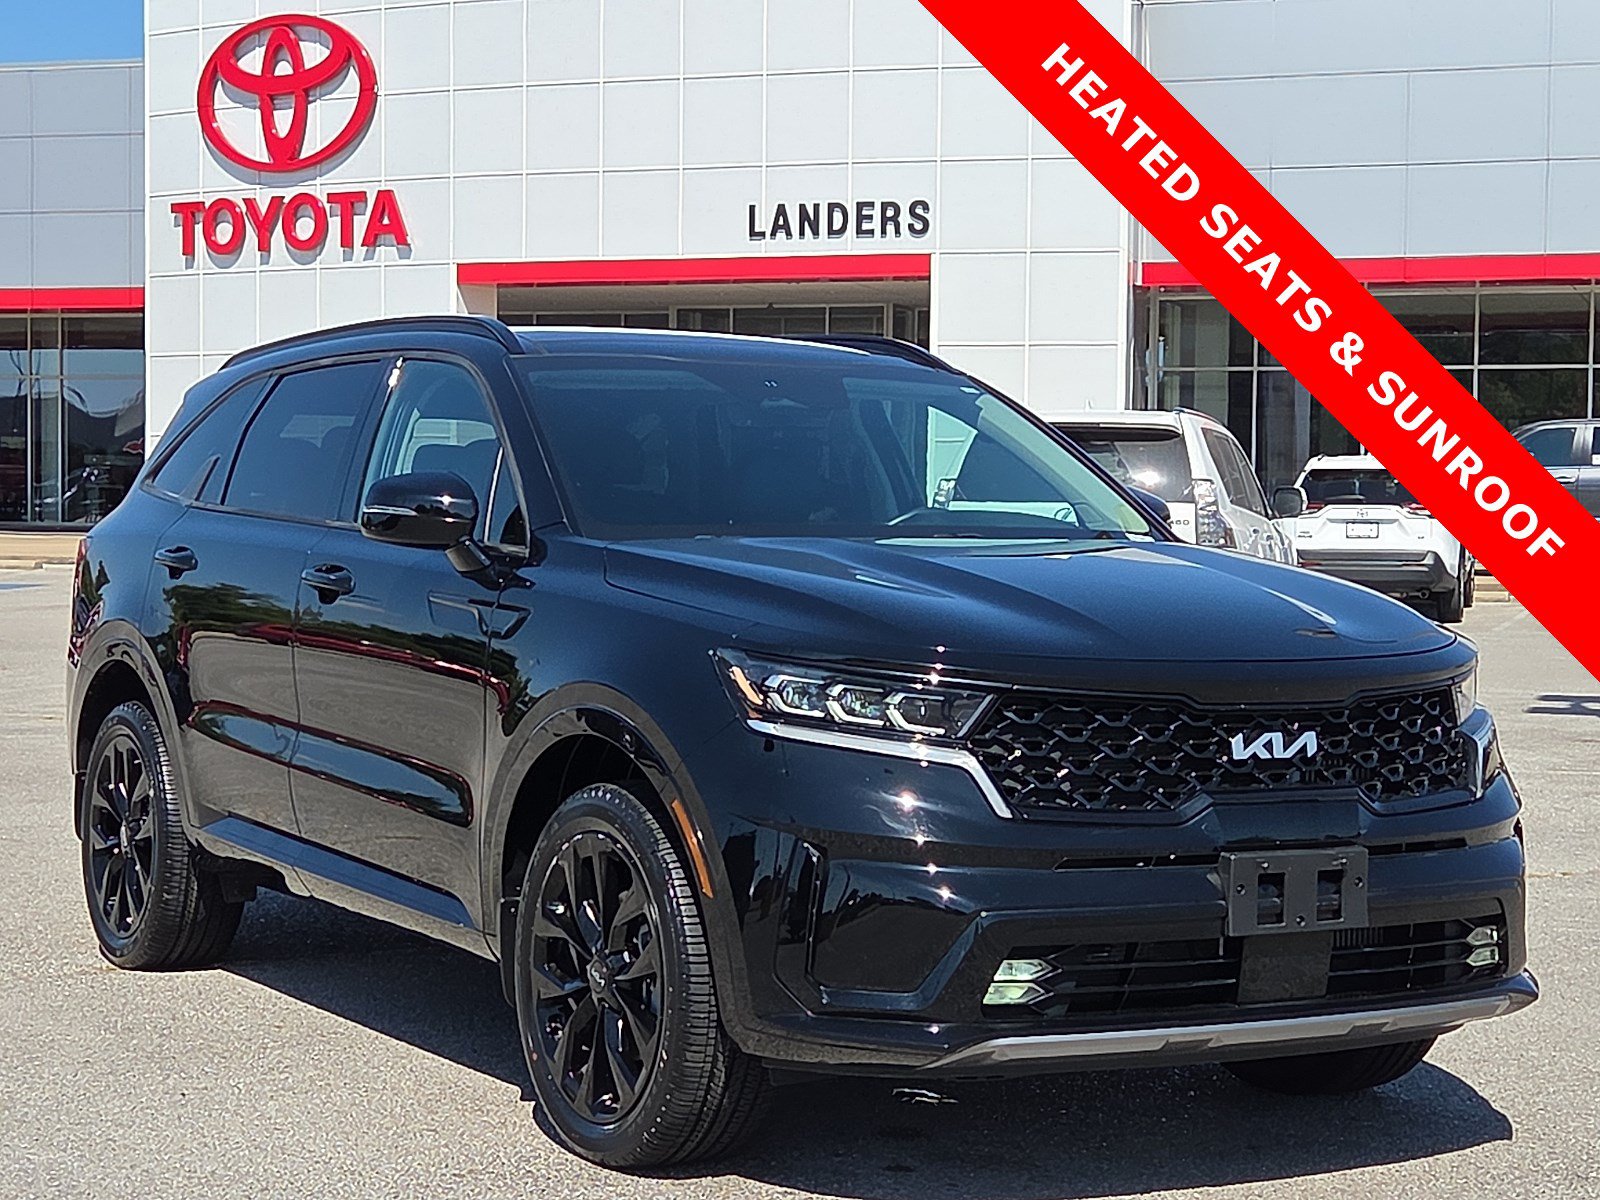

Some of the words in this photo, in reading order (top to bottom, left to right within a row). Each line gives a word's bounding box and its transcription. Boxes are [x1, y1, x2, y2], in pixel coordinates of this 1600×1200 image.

[171, 189, 410, 256] TOYOTA
[749, 199, 931, 241] LANDERS
[1231, 730, 1318, 761] KIA
